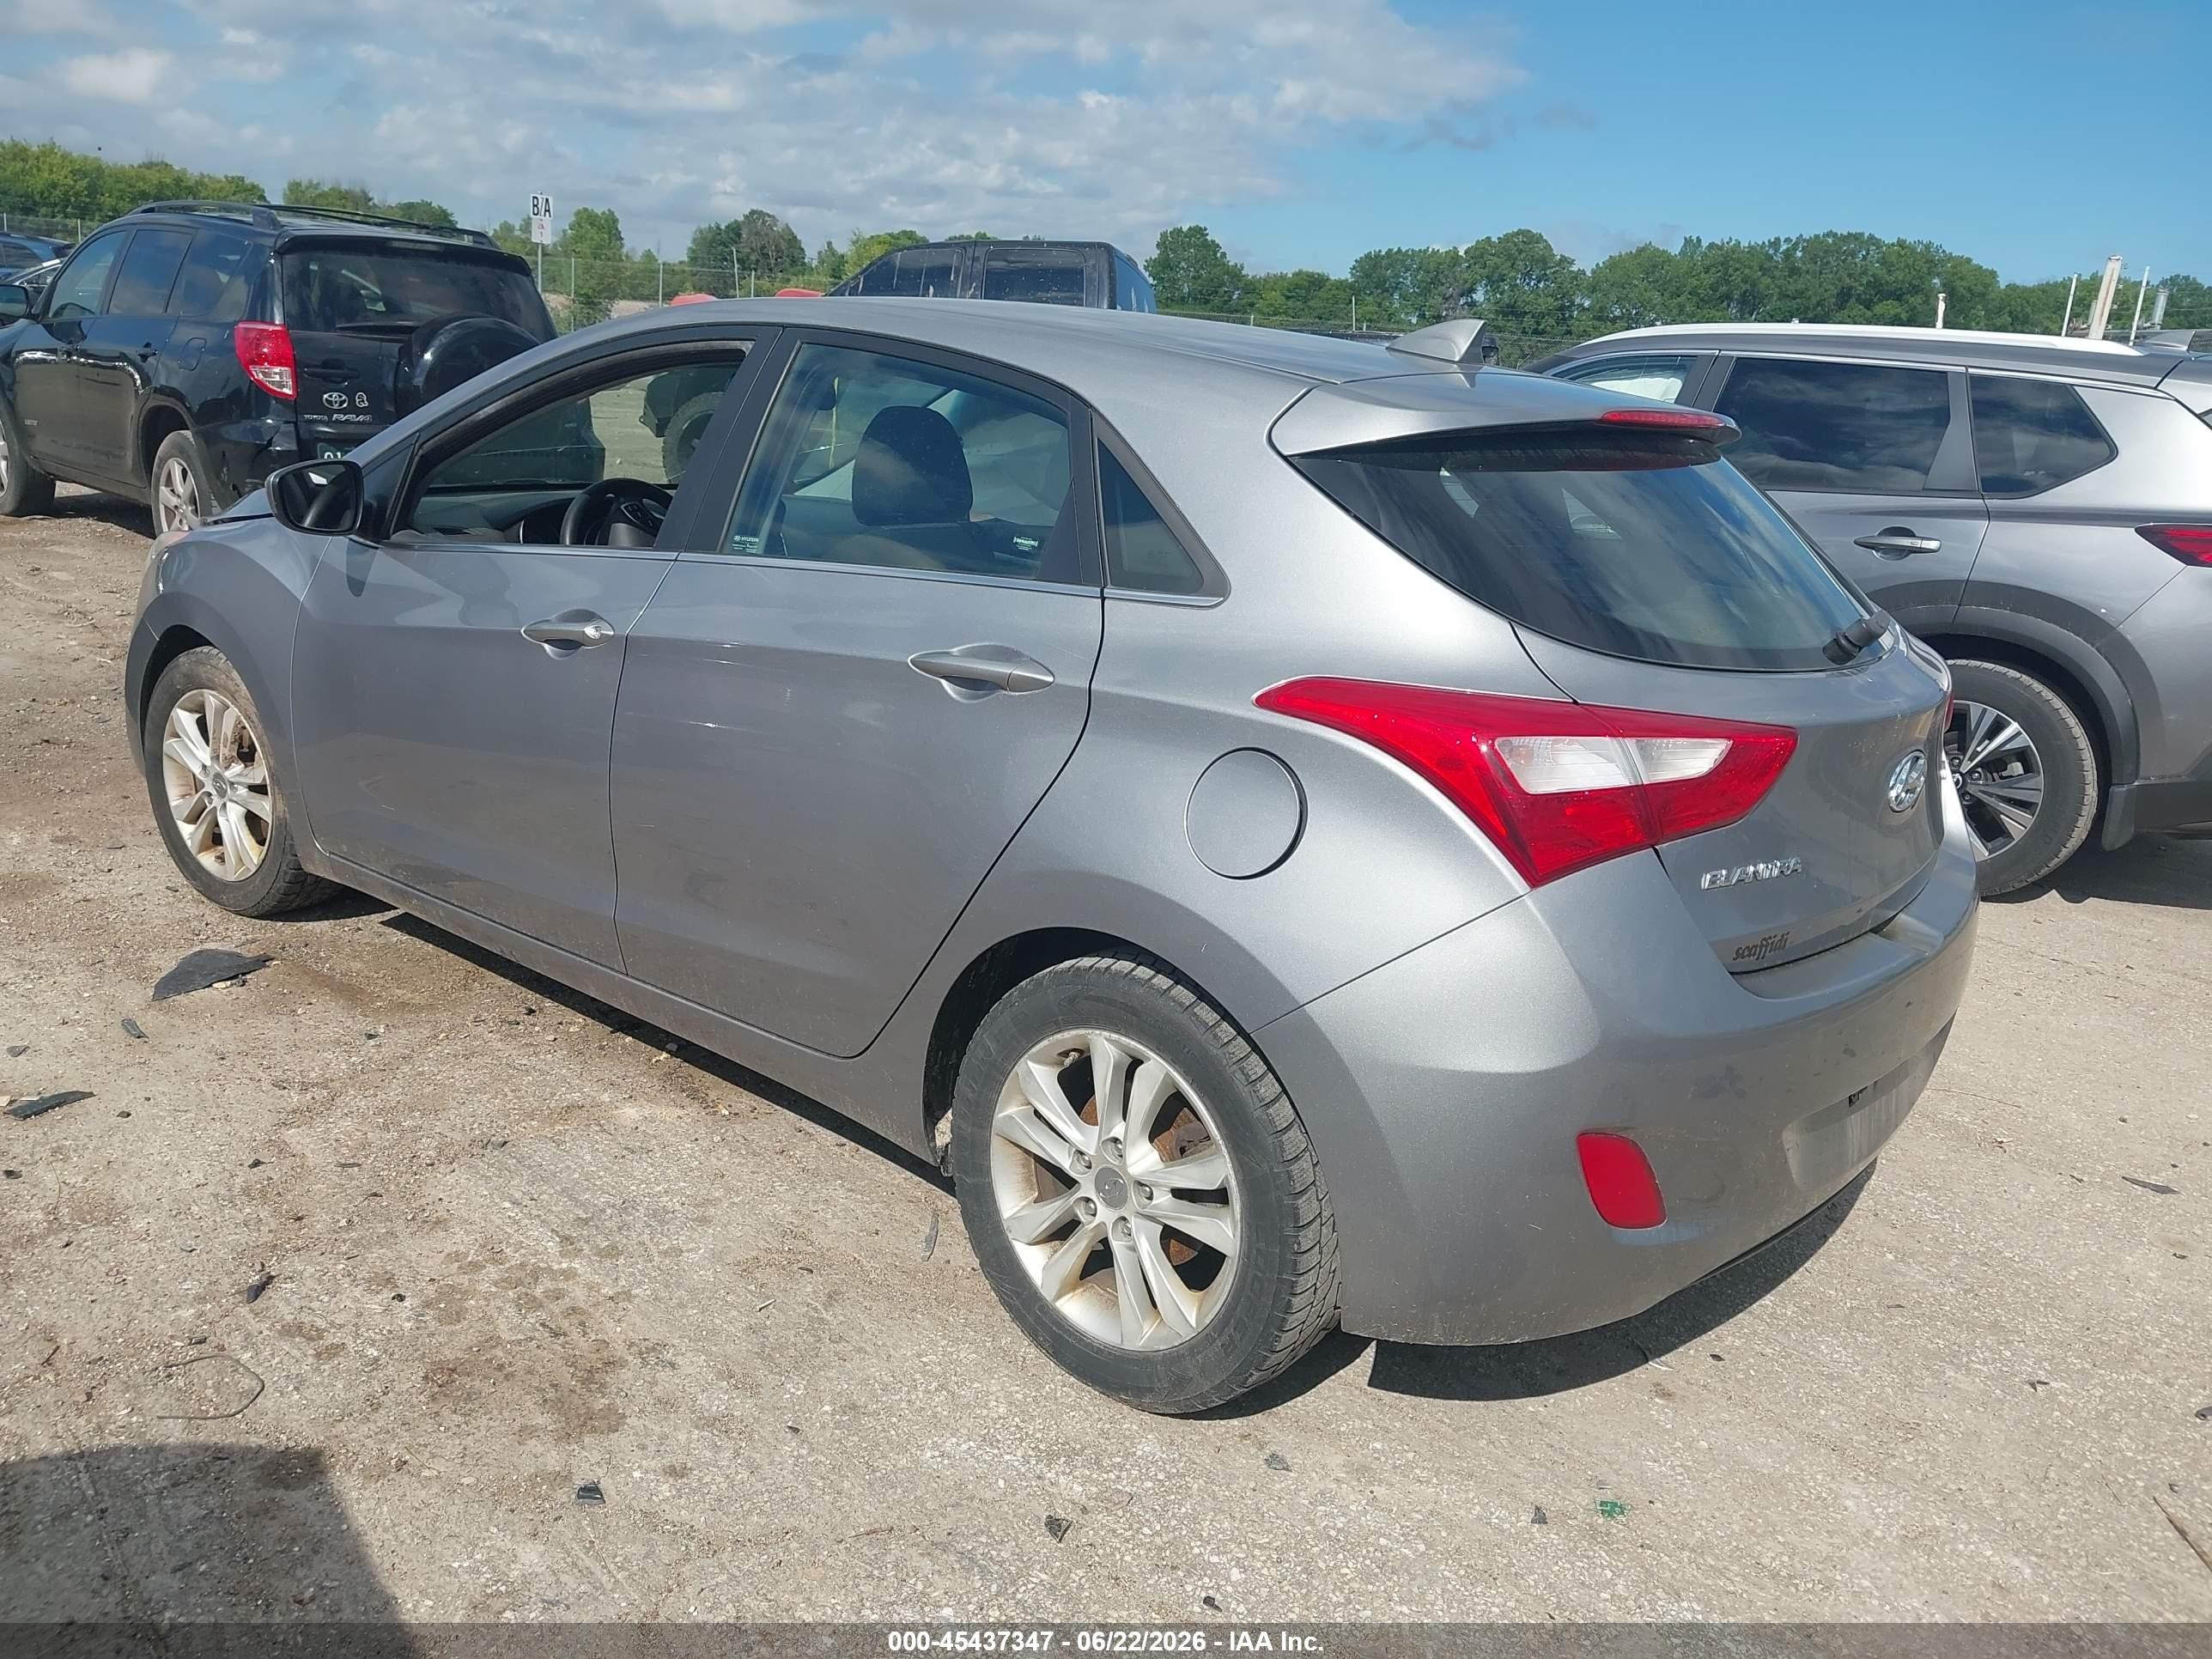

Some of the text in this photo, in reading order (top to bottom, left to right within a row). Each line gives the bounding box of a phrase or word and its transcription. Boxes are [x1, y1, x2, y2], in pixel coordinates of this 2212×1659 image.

[332, 414, 372, 422] RAV4
[1701, 857, 1802, 890] ELANTRA
[1733, 932, 1790, 961] scaffidi
